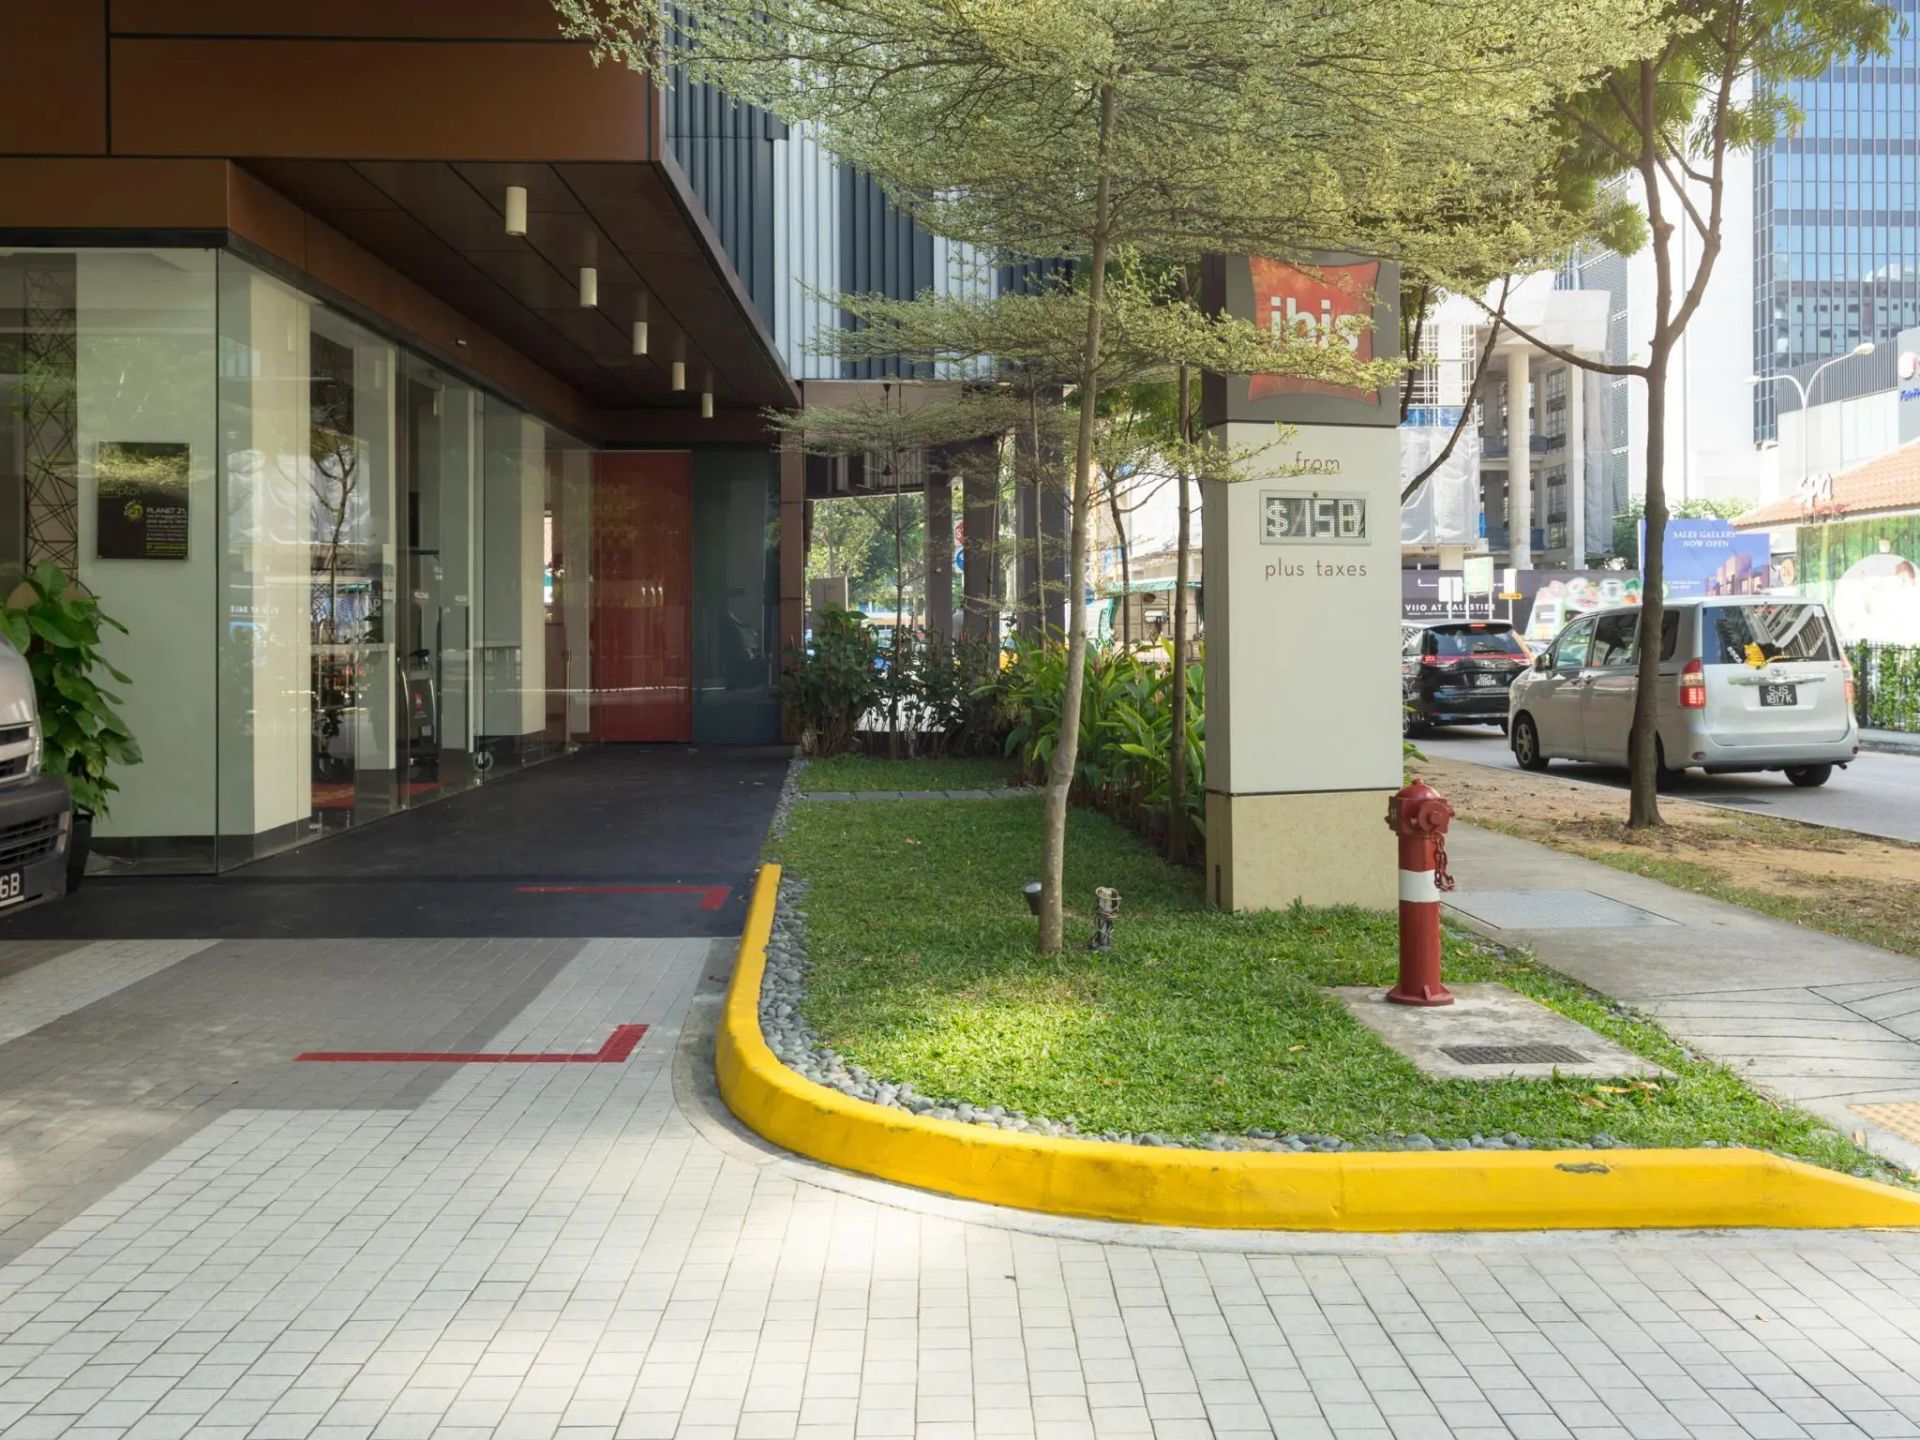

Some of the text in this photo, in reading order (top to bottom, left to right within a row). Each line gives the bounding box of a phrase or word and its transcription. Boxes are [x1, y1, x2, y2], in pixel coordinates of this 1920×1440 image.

[1271, 296, 1358, 353] ibis
[1295, 451, 1340, 471] from
[1265, 558, 1367, 581] plus taxes
[1768, 686, 1788, 695] SJS
